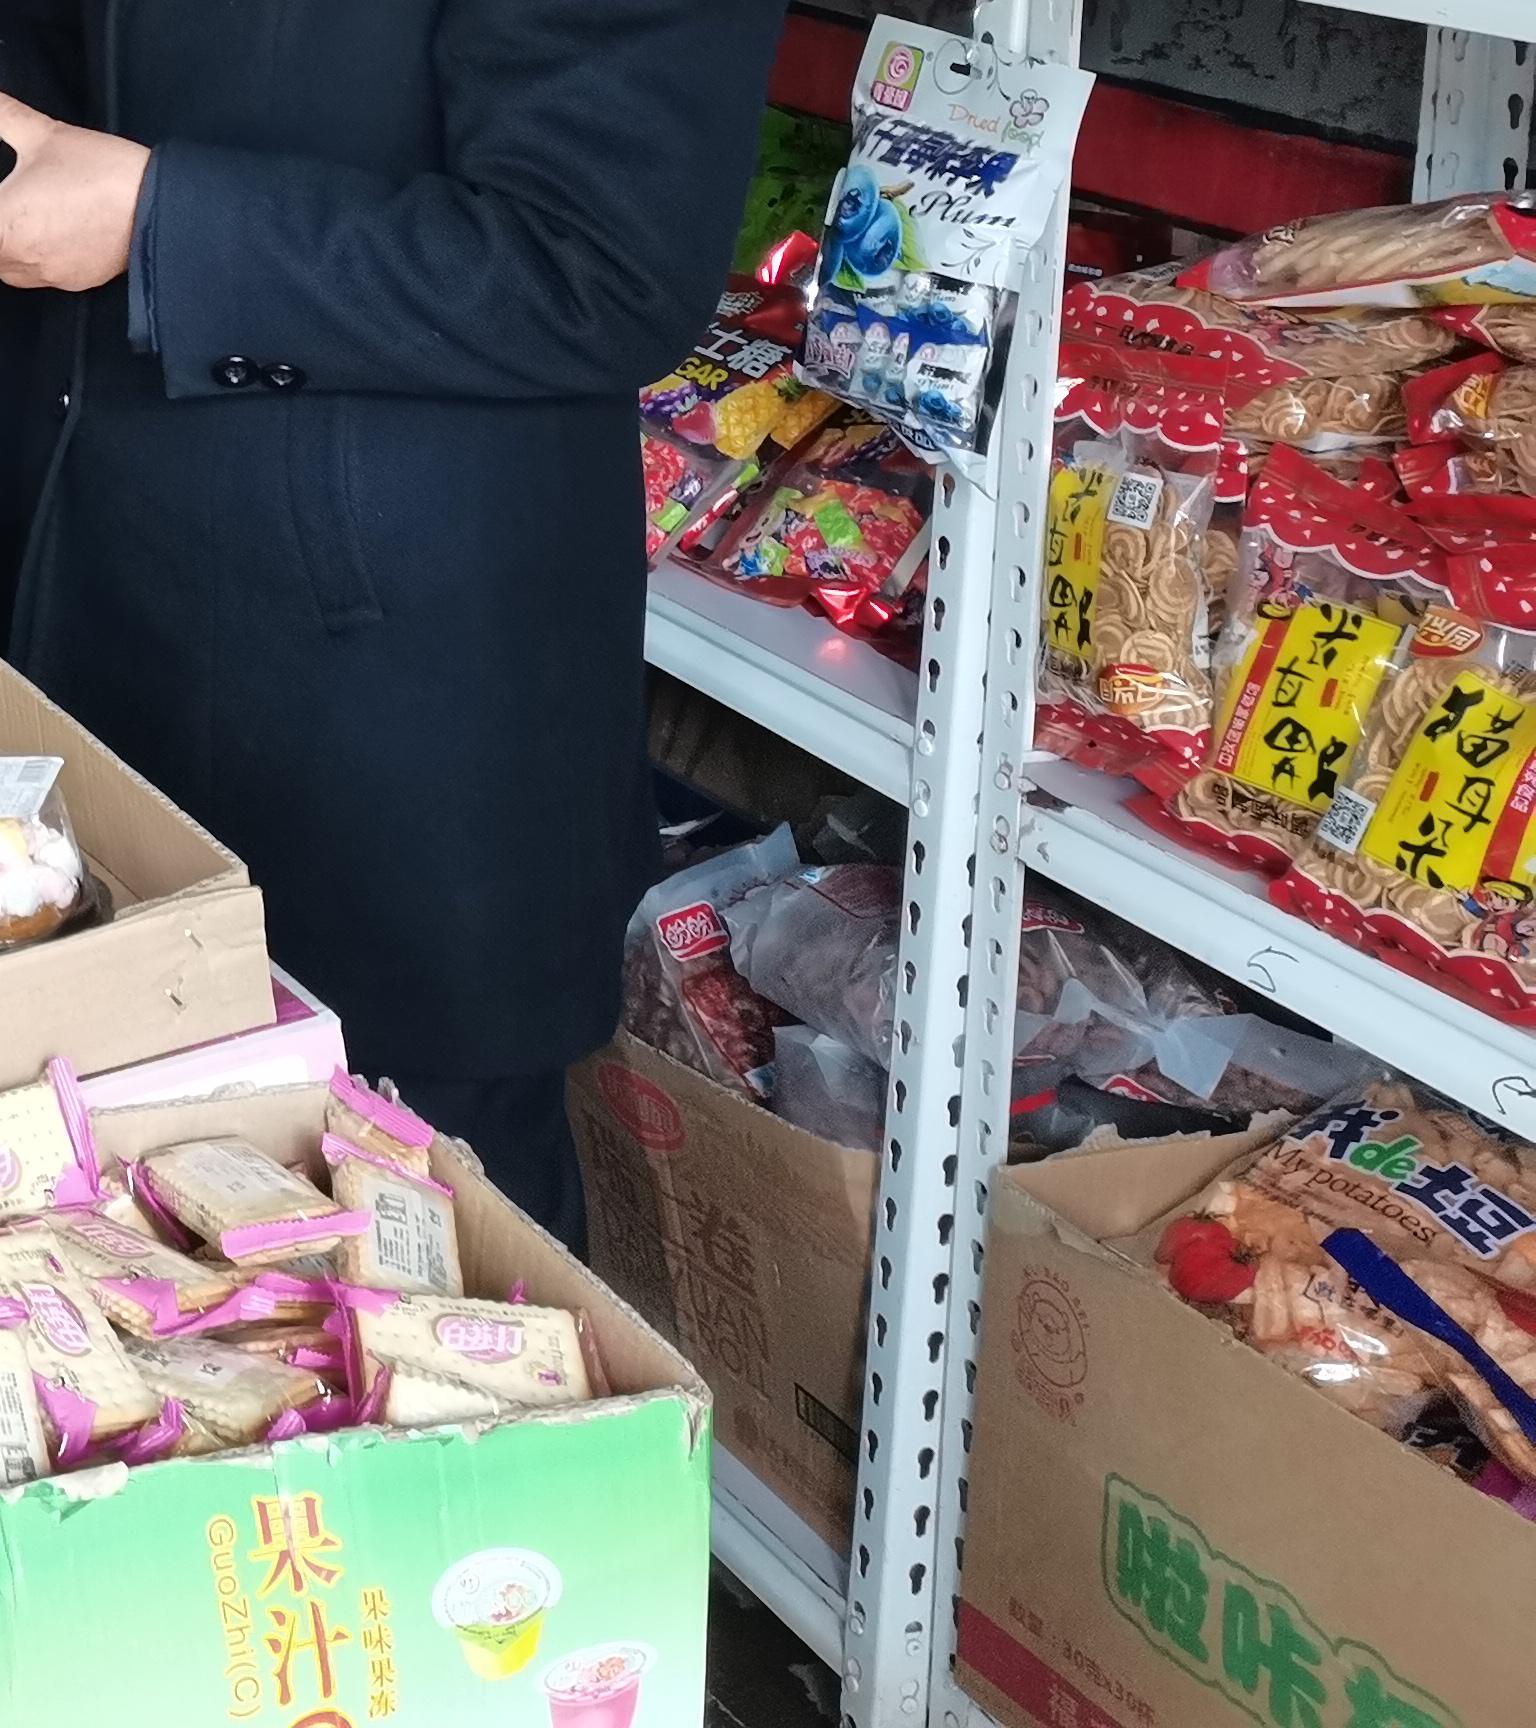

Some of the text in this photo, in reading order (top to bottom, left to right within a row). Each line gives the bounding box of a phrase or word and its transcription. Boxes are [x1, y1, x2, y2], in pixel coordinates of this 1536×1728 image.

[947, 103, 1000, 135] Dried
[908, 188, 1019, 231] Plum
[1308, 1159, 1437, 1246] potatoes
[248, 1489, 352, 1708] 果汁
[359, 1586, 401, 1720] 果味果冻
